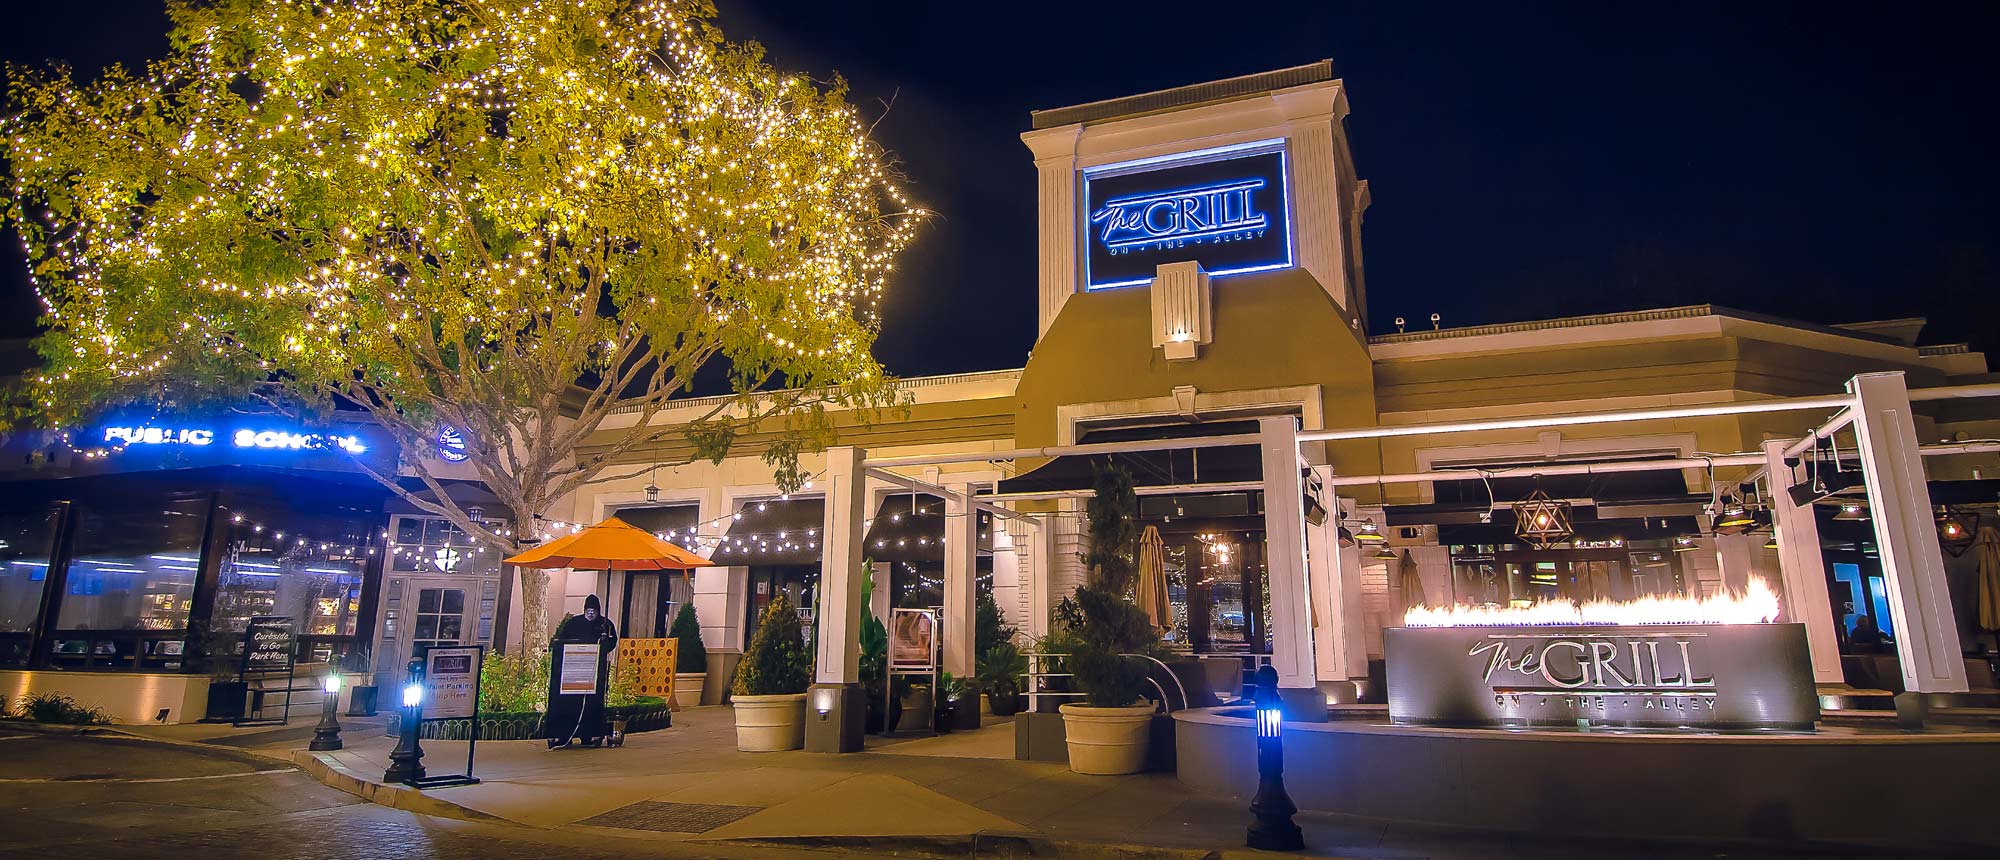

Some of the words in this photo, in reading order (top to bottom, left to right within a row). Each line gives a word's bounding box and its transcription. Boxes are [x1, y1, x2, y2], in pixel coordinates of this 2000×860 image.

[1092, 206, 1143, 240] The
[1143, 188, 1264, 236] GRILL
[1110, 246, 1128, 256] ON
[1157, 239, 1184, 251] THE
[1213, 229, 1264, 244] ALLEY
[104, 426, 214, 446] PUBLIC
[254, 632, 289, 641] Curbside
[269, 642, 281, 650] Go
[250, 652, 269, 660] Park
[269, 651, 289, 660] Here
[1469, 641, 1542, 684] The
[1540, 640, 1716, 689] GRILL
[446, 682, 474, 690] Parking
[1494, 695, 1520, 708] ON
[1565, 698, 1604, 710] THE
[1645, 698, 1716, 710] ALLEY
